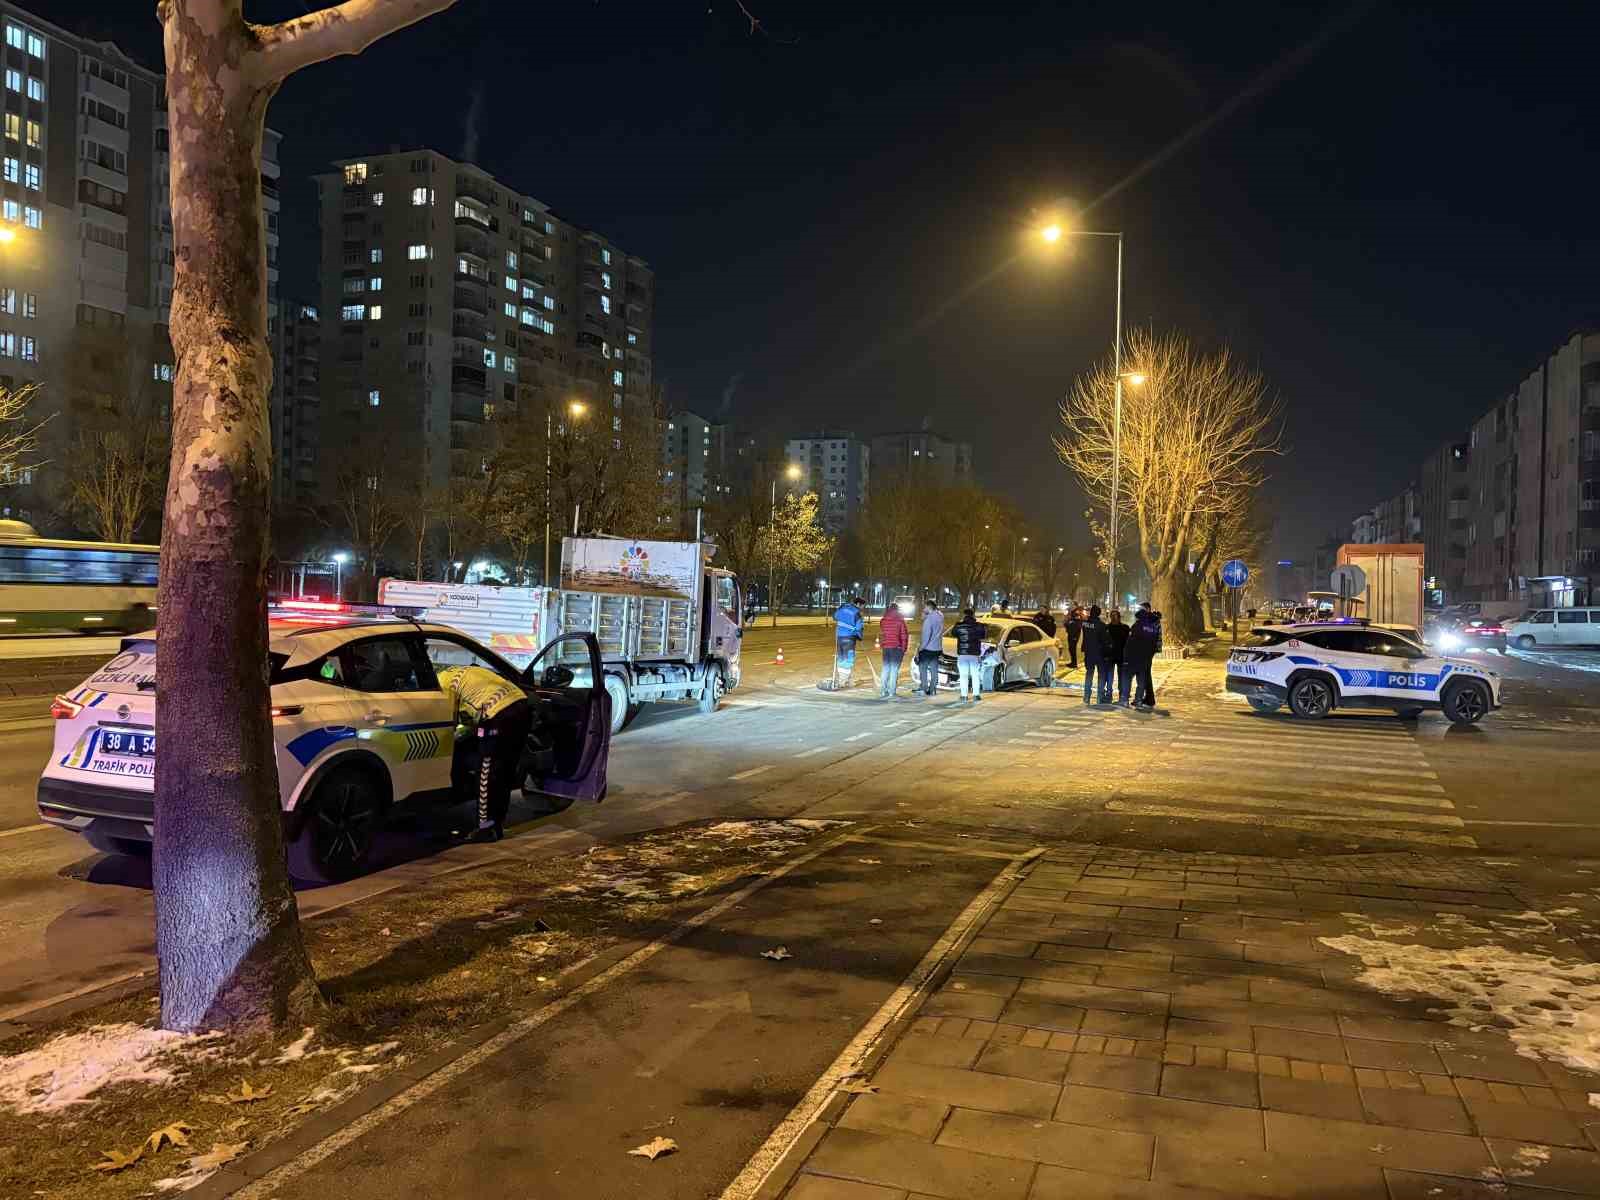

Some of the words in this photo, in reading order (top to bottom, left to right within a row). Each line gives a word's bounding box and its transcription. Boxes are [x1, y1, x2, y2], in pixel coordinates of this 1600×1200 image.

[1388, 673, 1426, 687] POLİS
[107, 734, 121, 750] 38
[128, 736, 136, 751] A
[93, 759, 127, 772] TRAFİK
[128, 763, 156, 775] POLİ
